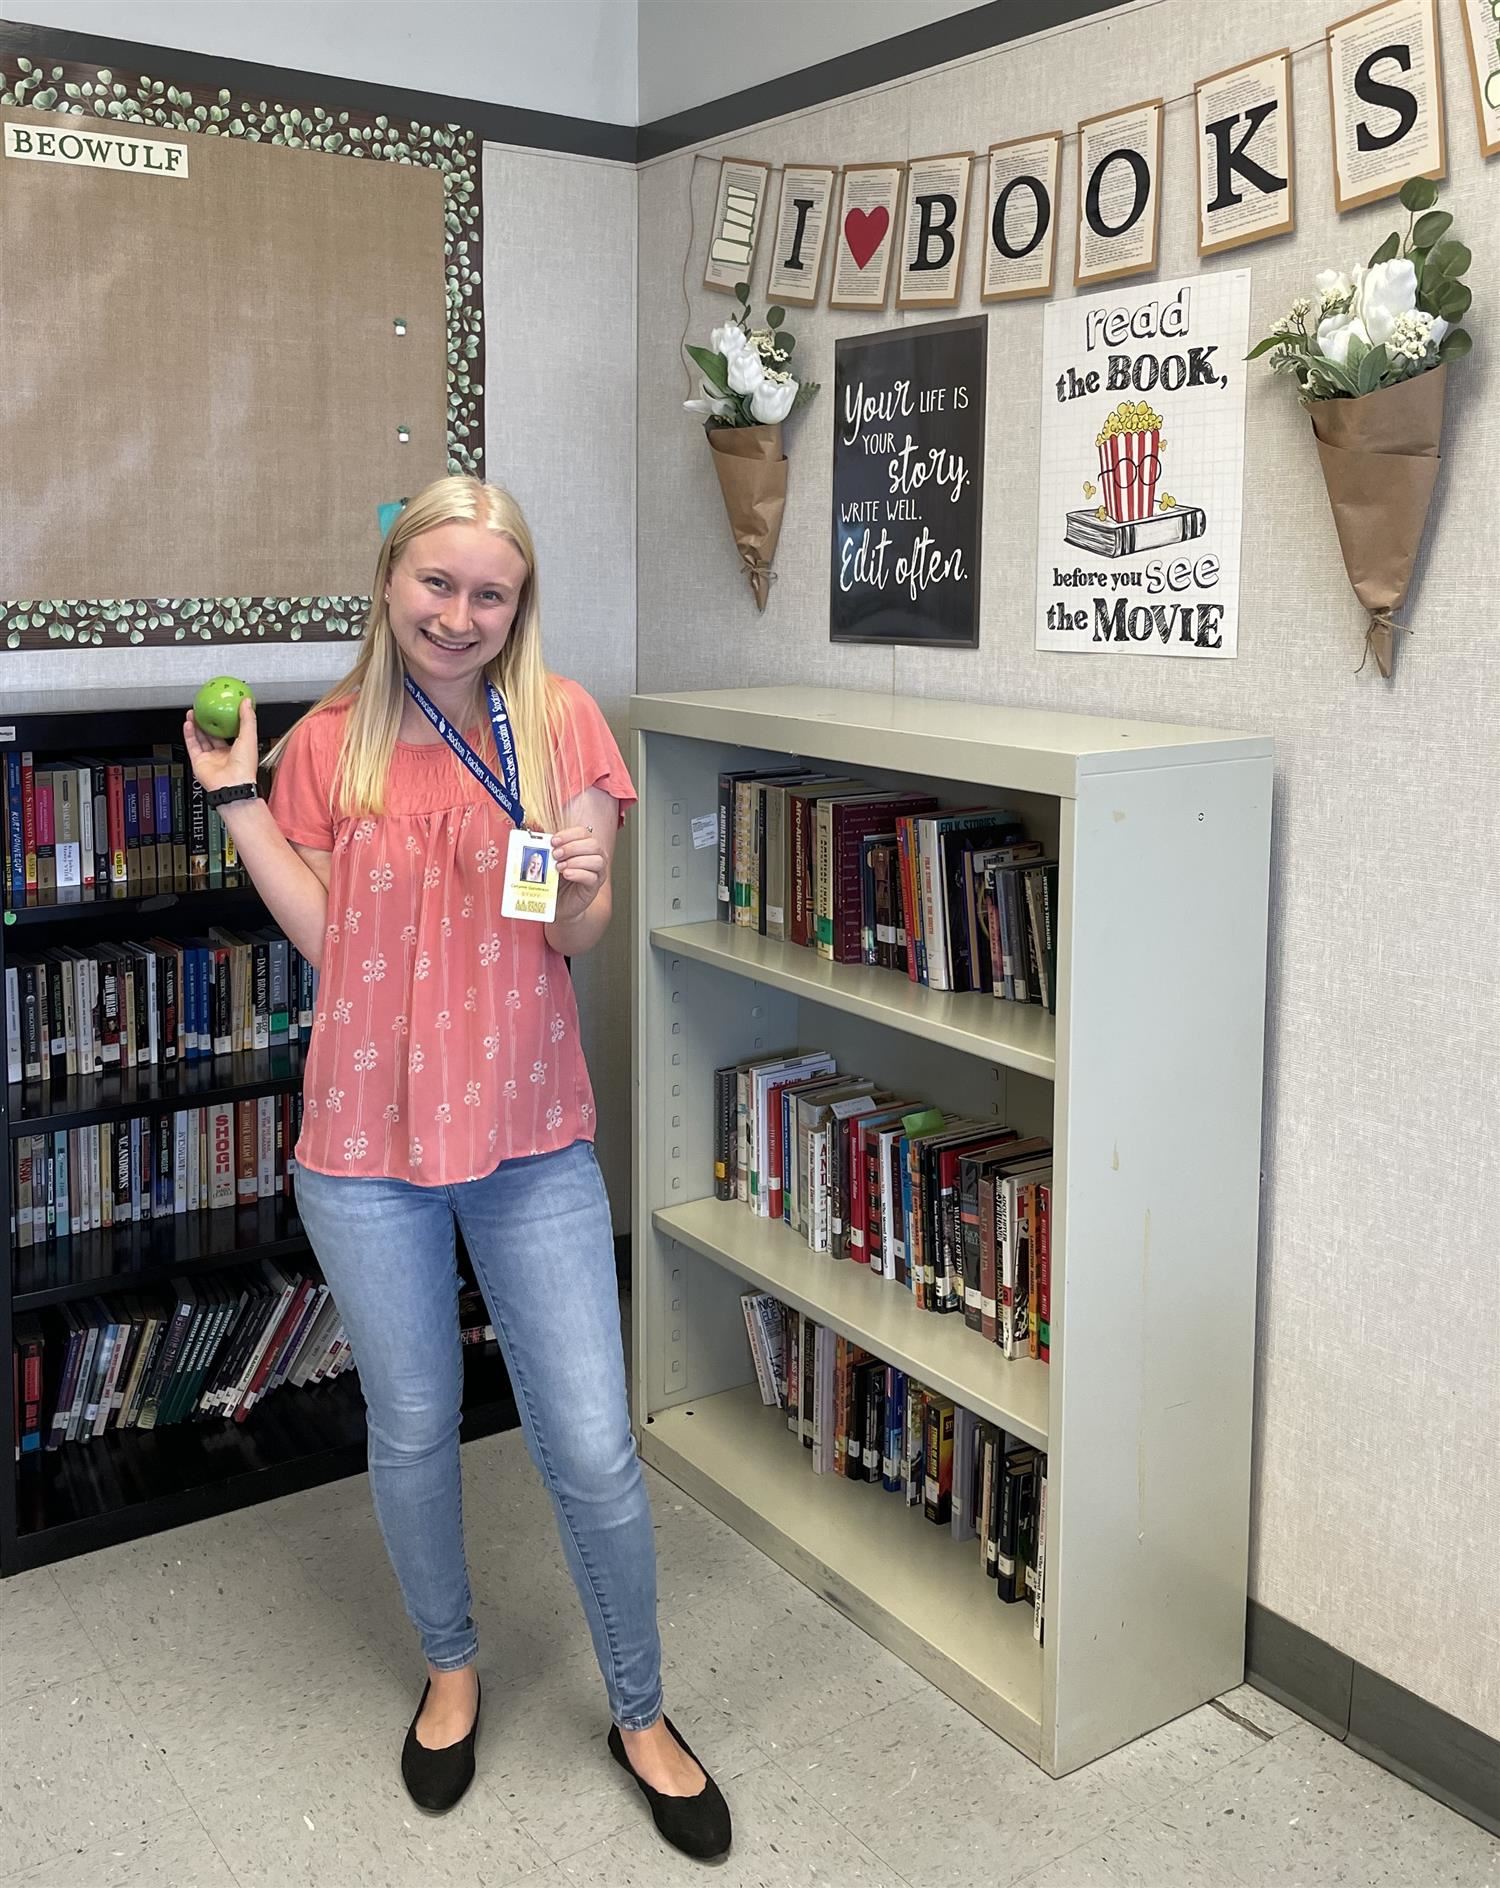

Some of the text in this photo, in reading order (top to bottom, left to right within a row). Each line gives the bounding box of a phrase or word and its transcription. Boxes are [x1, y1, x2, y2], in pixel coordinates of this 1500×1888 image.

[13, 130, 183, 172] BEOWULF
[784, 45, 1419, 273] I BOOKS
[1086, 287, 1191, 351] read
[1055, 346, 1229, 403] the BOOK,
[843, 380, 969, 445] Your LIFE IS
[862, 433, 971, 502] YOUR story.
[841, 499, 923, 523] WRITE WELL.
[840, 526, 969, 601] Edit often.
[1053, 553, 1221, 593] before you see
[1046, 598, 1224, 649] the MOVIE
[447, 728, 513, 812] Stockton Teachers Association
[11, 811, 22, 873] KURT VONNEGUT
[193, 802, 204, 841] THIEF
[114, 853, 123, 875] USED
[719, 805, 728, 887] MANHATTAN PROJEC
[795, 800, 804, 922] Afro-American Folklore
[925, 871, 933, 894] STORIES
[926, 896, 934, 905] OF
[927, 916, 935, 935] SOUTH
[257, 957, 266, 977] DAN
[105, 976, 117, 1018] JOHN WALSH
[257, 978, 266, 1009] BROWN
[953, 1205, 961, 1242] WALKER
[996, 1200, 1004, 1243] PATTERSON
[954, 1243, 961, 1254] OF
[930, 1425, 938, 1449] STRONG
[930, 1449, 938, 1458] OF
